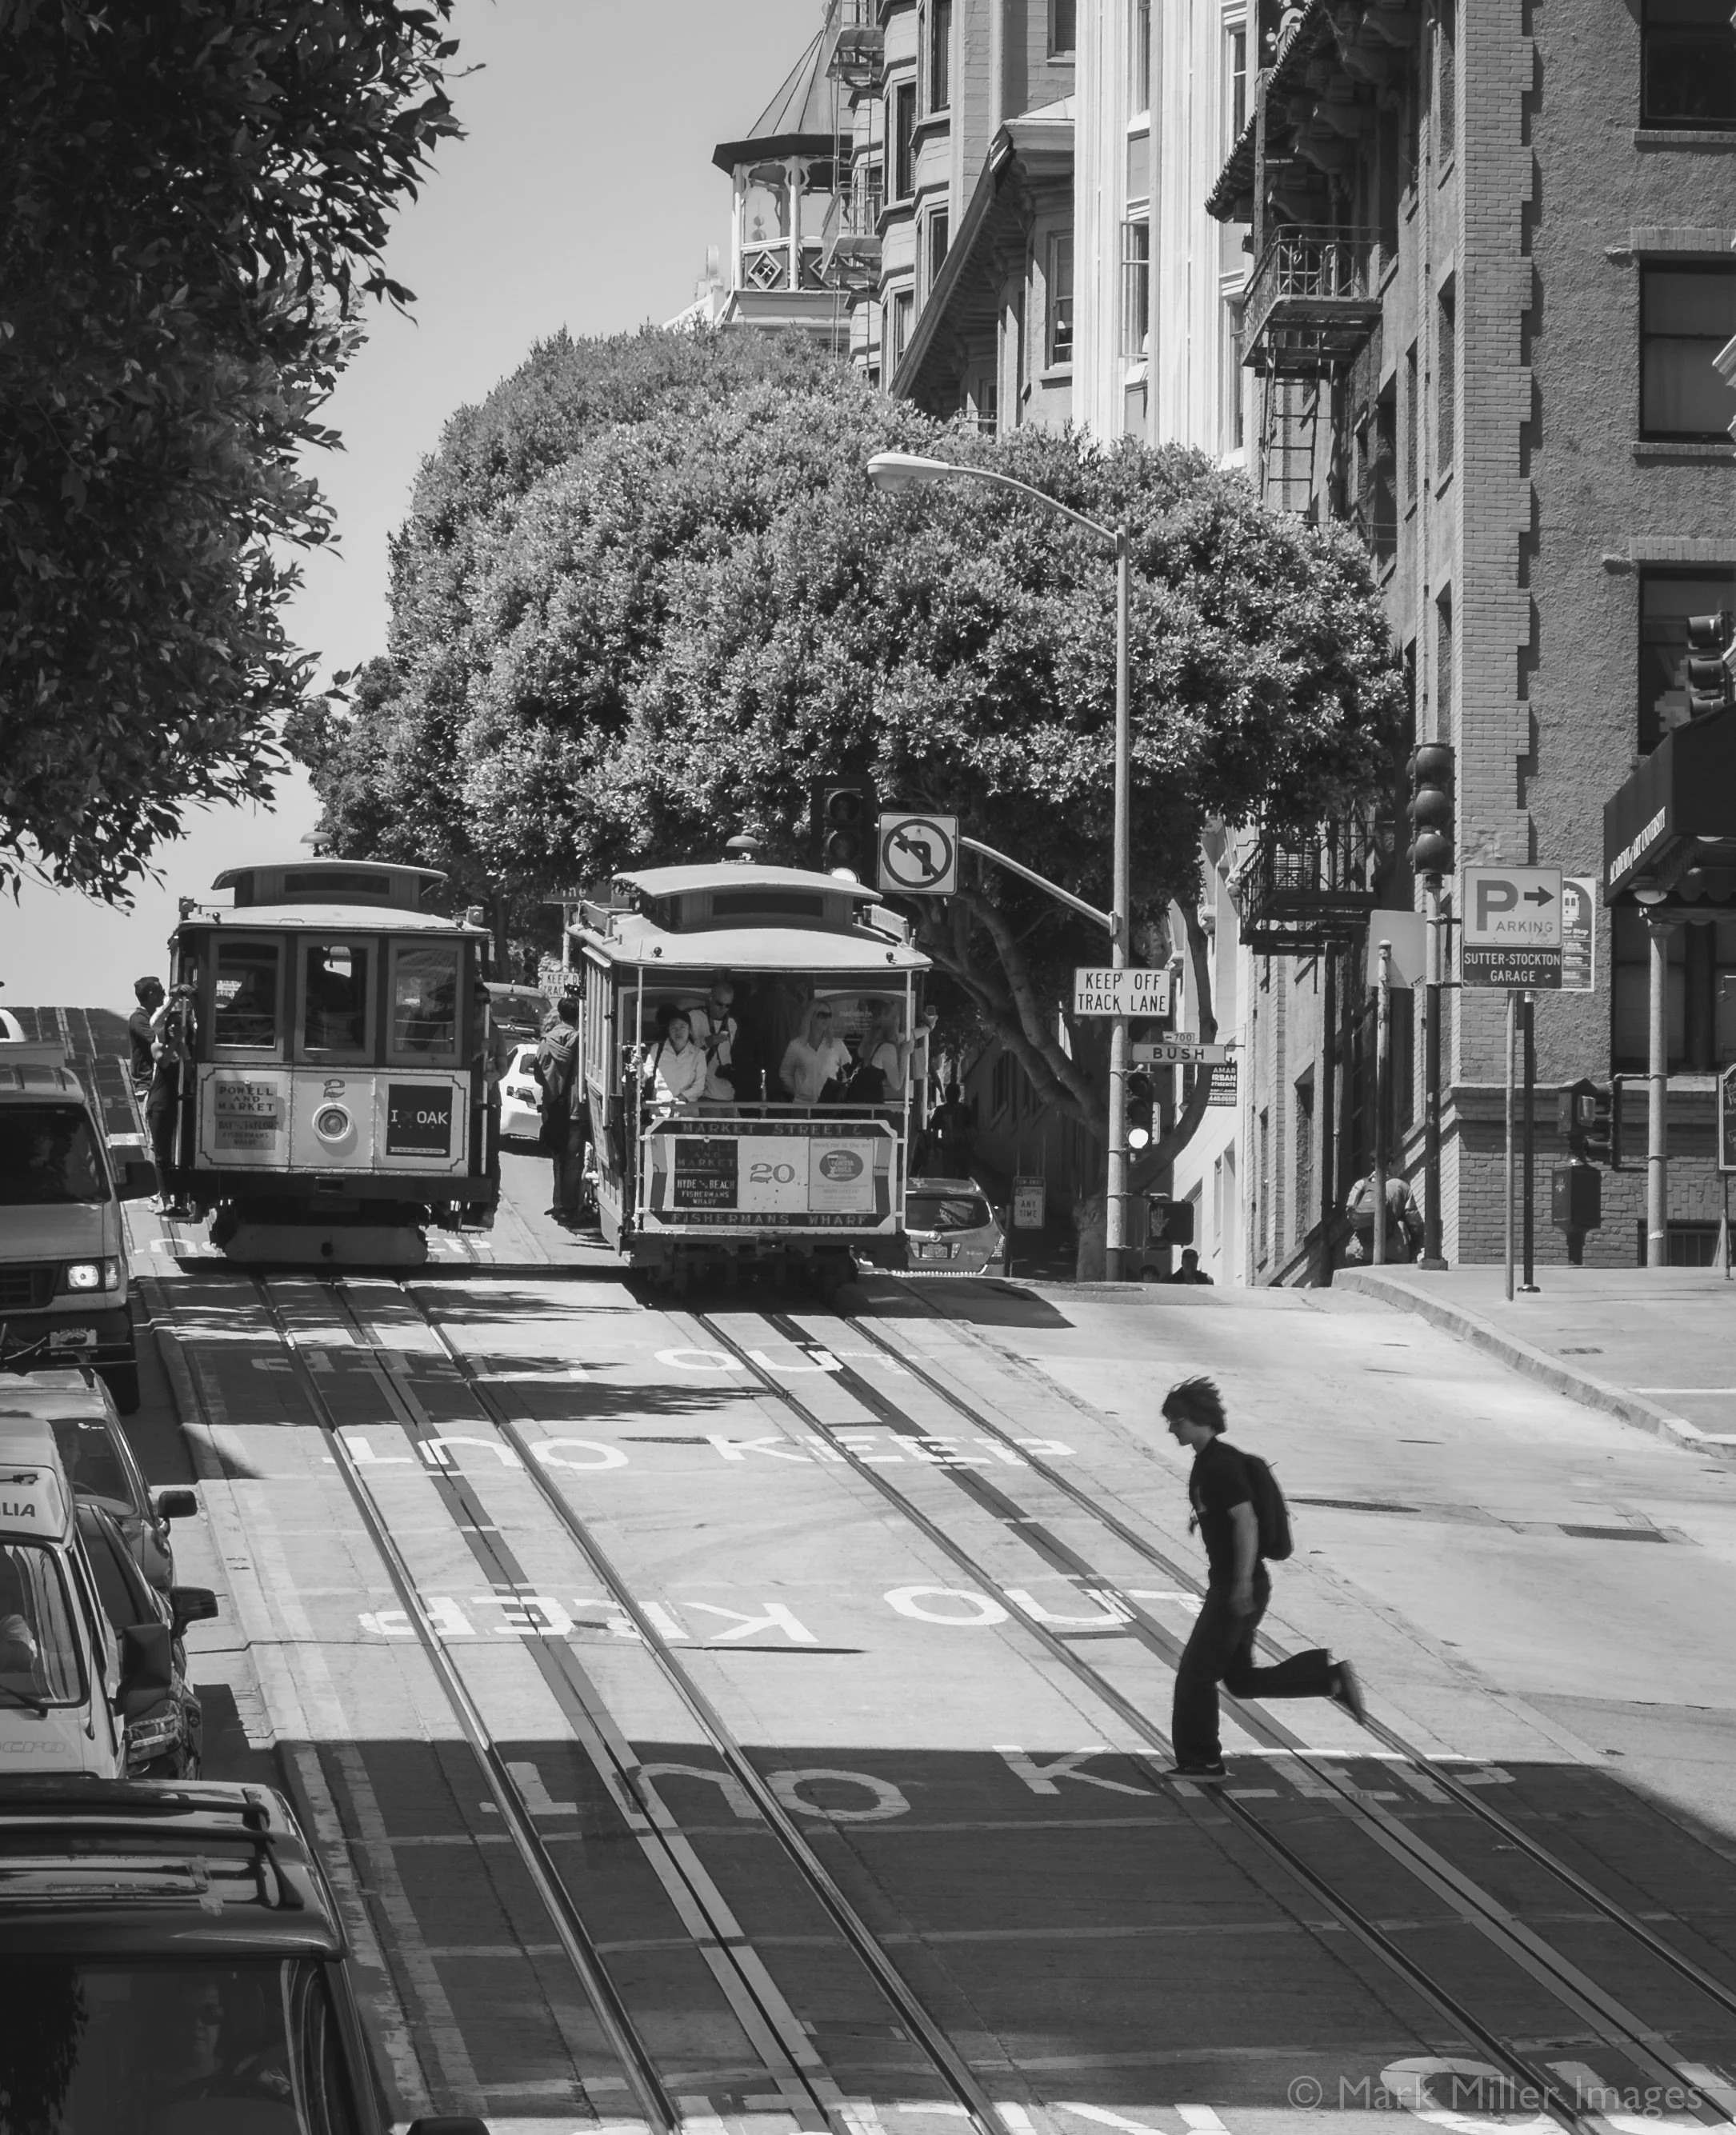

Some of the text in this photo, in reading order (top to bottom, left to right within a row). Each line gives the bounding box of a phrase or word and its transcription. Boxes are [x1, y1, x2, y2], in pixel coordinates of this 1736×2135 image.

[1464, 953, 1561, 966] SUTTER-STOCKTON
[1086, 973, 1161, 990] KEEP OFF
[1490, 970, 1536, 982] GARAGE
[1078, 994, 1166, 1014] TRACK LANE
[1153, 1047, 1206, 1060] BUSH
[219, 1086, 274, 1096] POWELL
[323, 1079, 346, 1097] 2
[218, 1102, 274, 1111] MARKET
[391, 1109, 448, 1125] I OAK
[682, 1123, 755, 1134] MARKET
[773, 1124, 845, 1136] STREET
[677, 1158, 735, 1167] MARKET
[750, 1163, 795, 1184] 20
[709, 1179, 735, 1189] BEACH
[671, 1213, 868, 1225] FISHERMANS WHARF
[706, 1434, 1077, 1466] KEEP
[0, 1502, 35, 1517] LIA
[0, 1741, 66, 1753] cro
